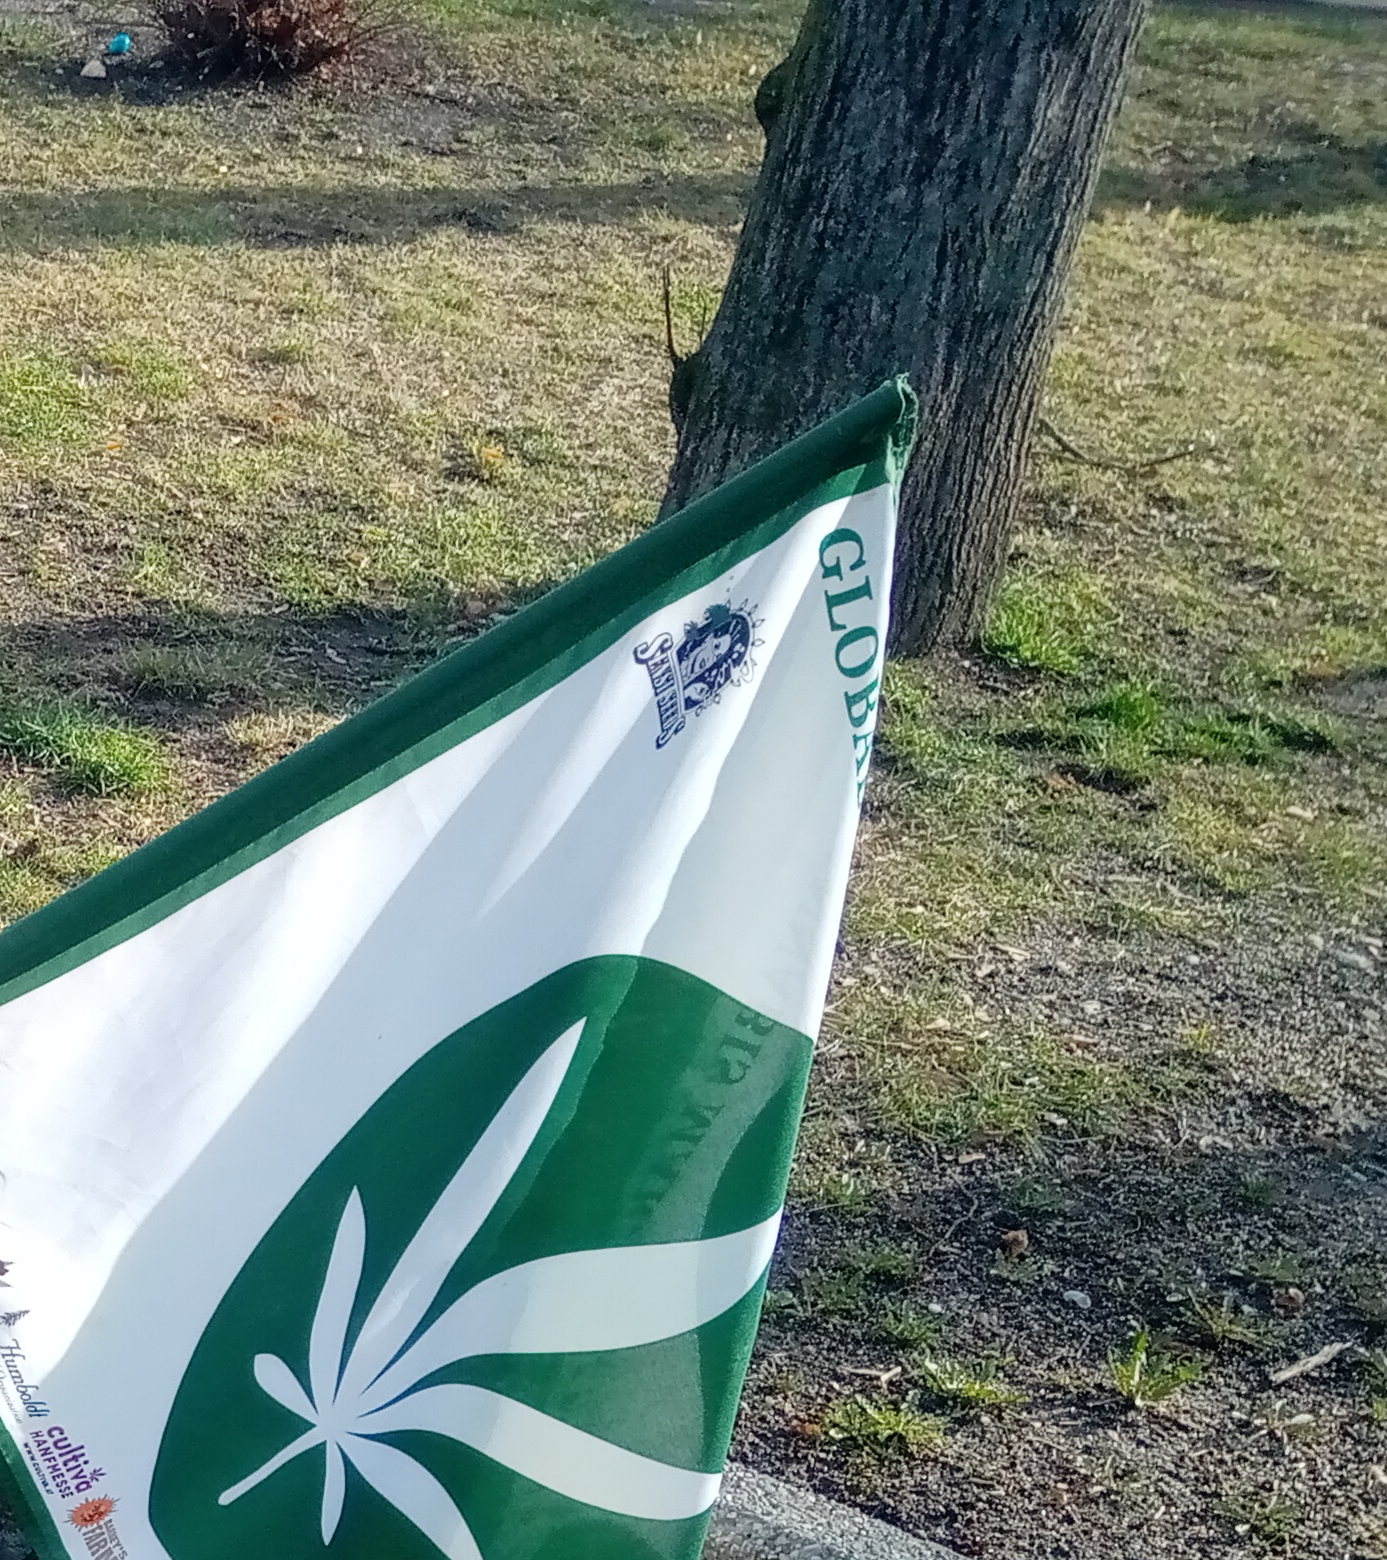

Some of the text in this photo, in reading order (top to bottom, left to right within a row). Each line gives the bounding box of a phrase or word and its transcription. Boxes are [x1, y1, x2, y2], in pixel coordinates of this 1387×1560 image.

[633, 632, 686, 750] SENSI SEEDS
[818, 527, 880, 809] GLOB
[30, 1430, 74, 1499] HANFMESSE
[47, 1425, 93, 1494] cultiva
